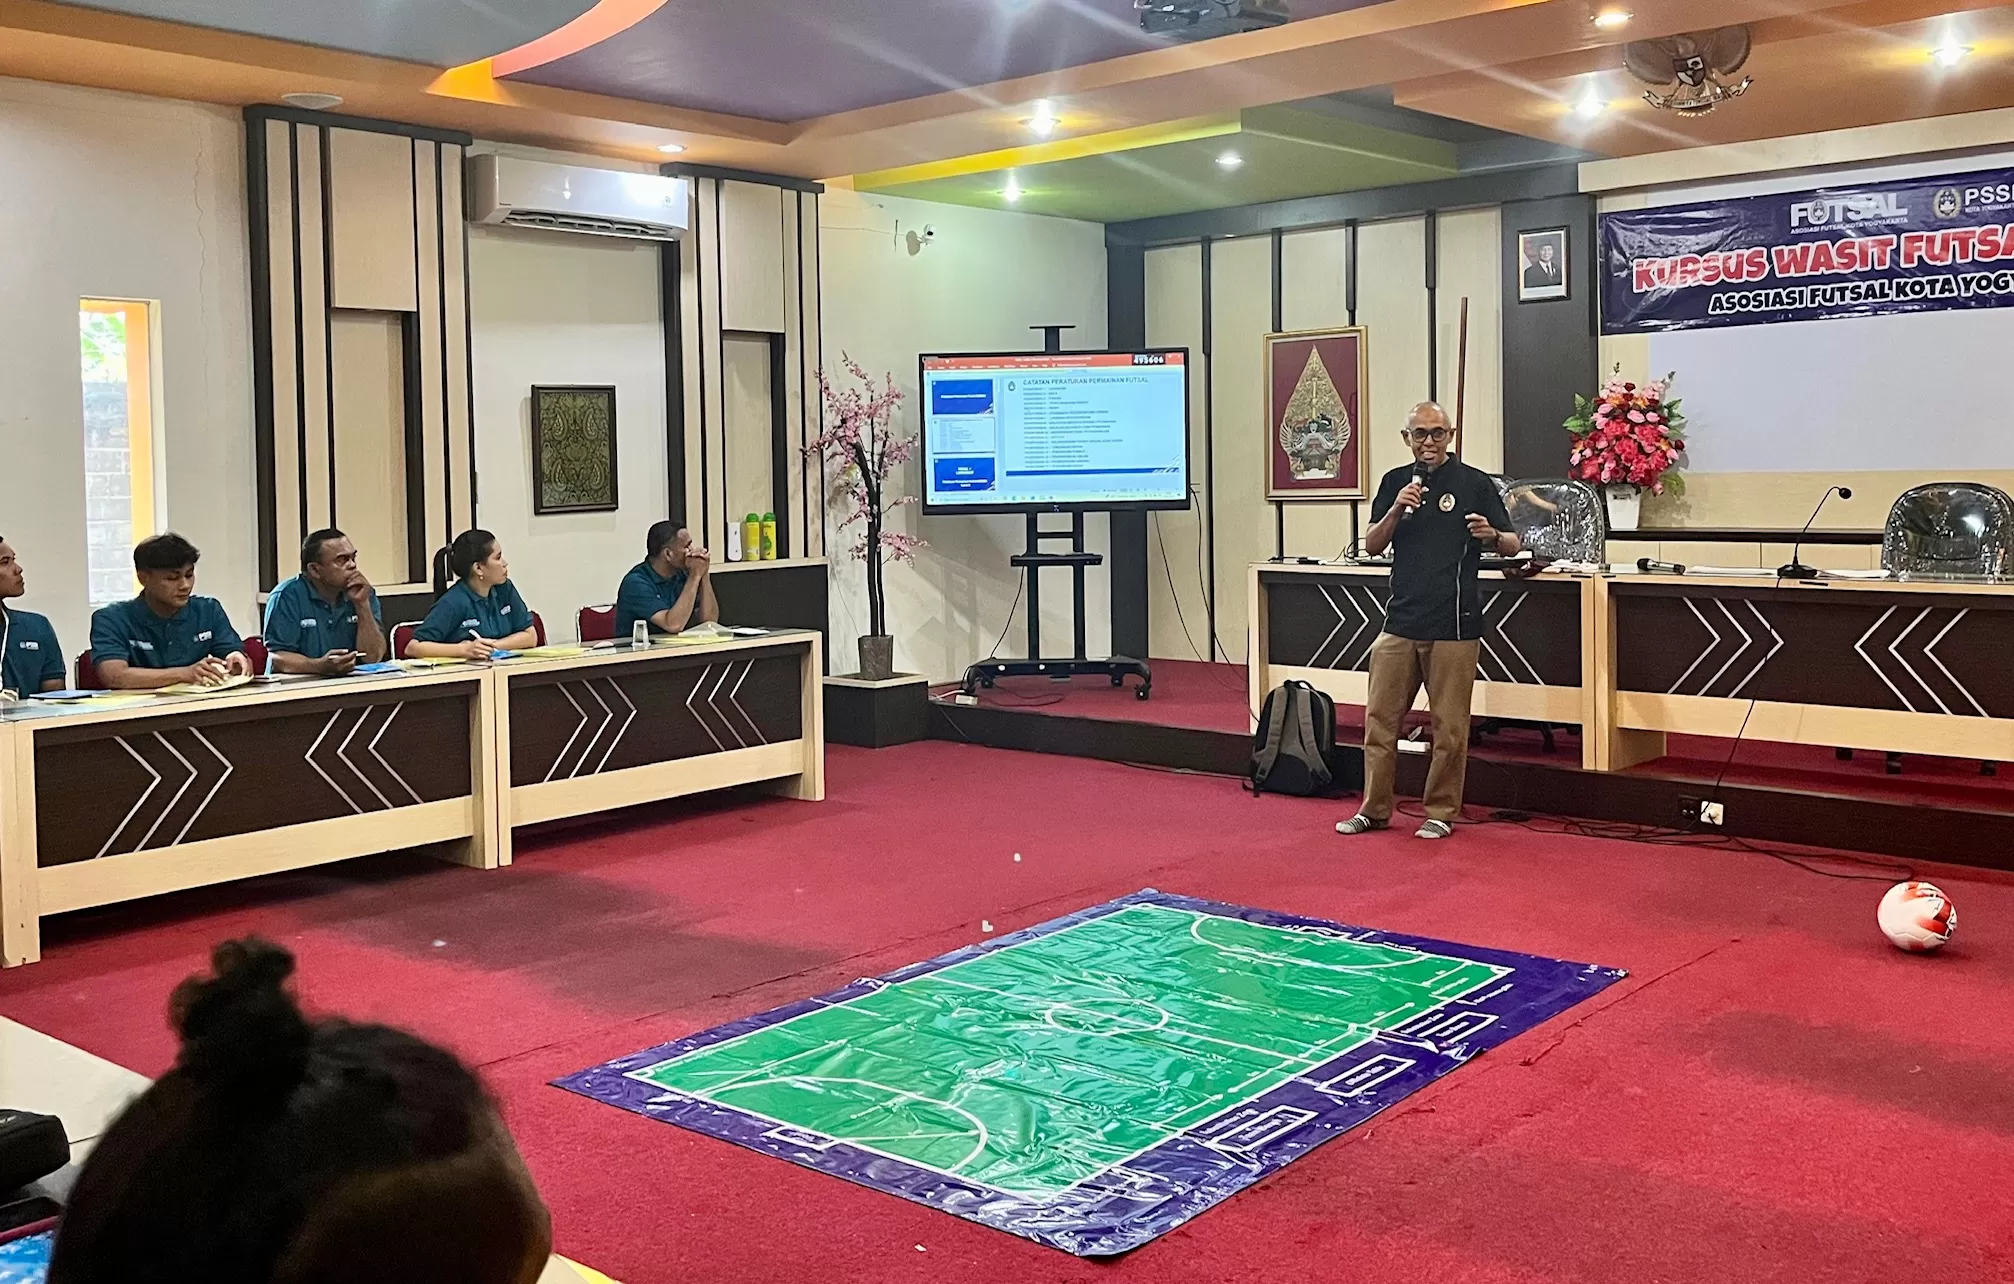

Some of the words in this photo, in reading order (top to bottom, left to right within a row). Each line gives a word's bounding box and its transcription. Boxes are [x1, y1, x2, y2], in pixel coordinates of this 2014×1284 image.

[1790, 192, 1908, 228] FUTSAL
[1790, 225, 1820, 235] ASOSIASI
[1820, 222, 1845, 232] FUTSAL
[1846, 219, 1863, 229] KOTA
[1863, 216, 1908, 227] YOGYAKARTA
[1632, 247, 1771, 293] KURSUS
[1771, 234, 1897, 278] WASIT
[1708, 286, 1807, 314] ASOSIASI
[1807, 279, 1894, 308] FUTSAL
[1893, 273, 1959, 301] KOTA
